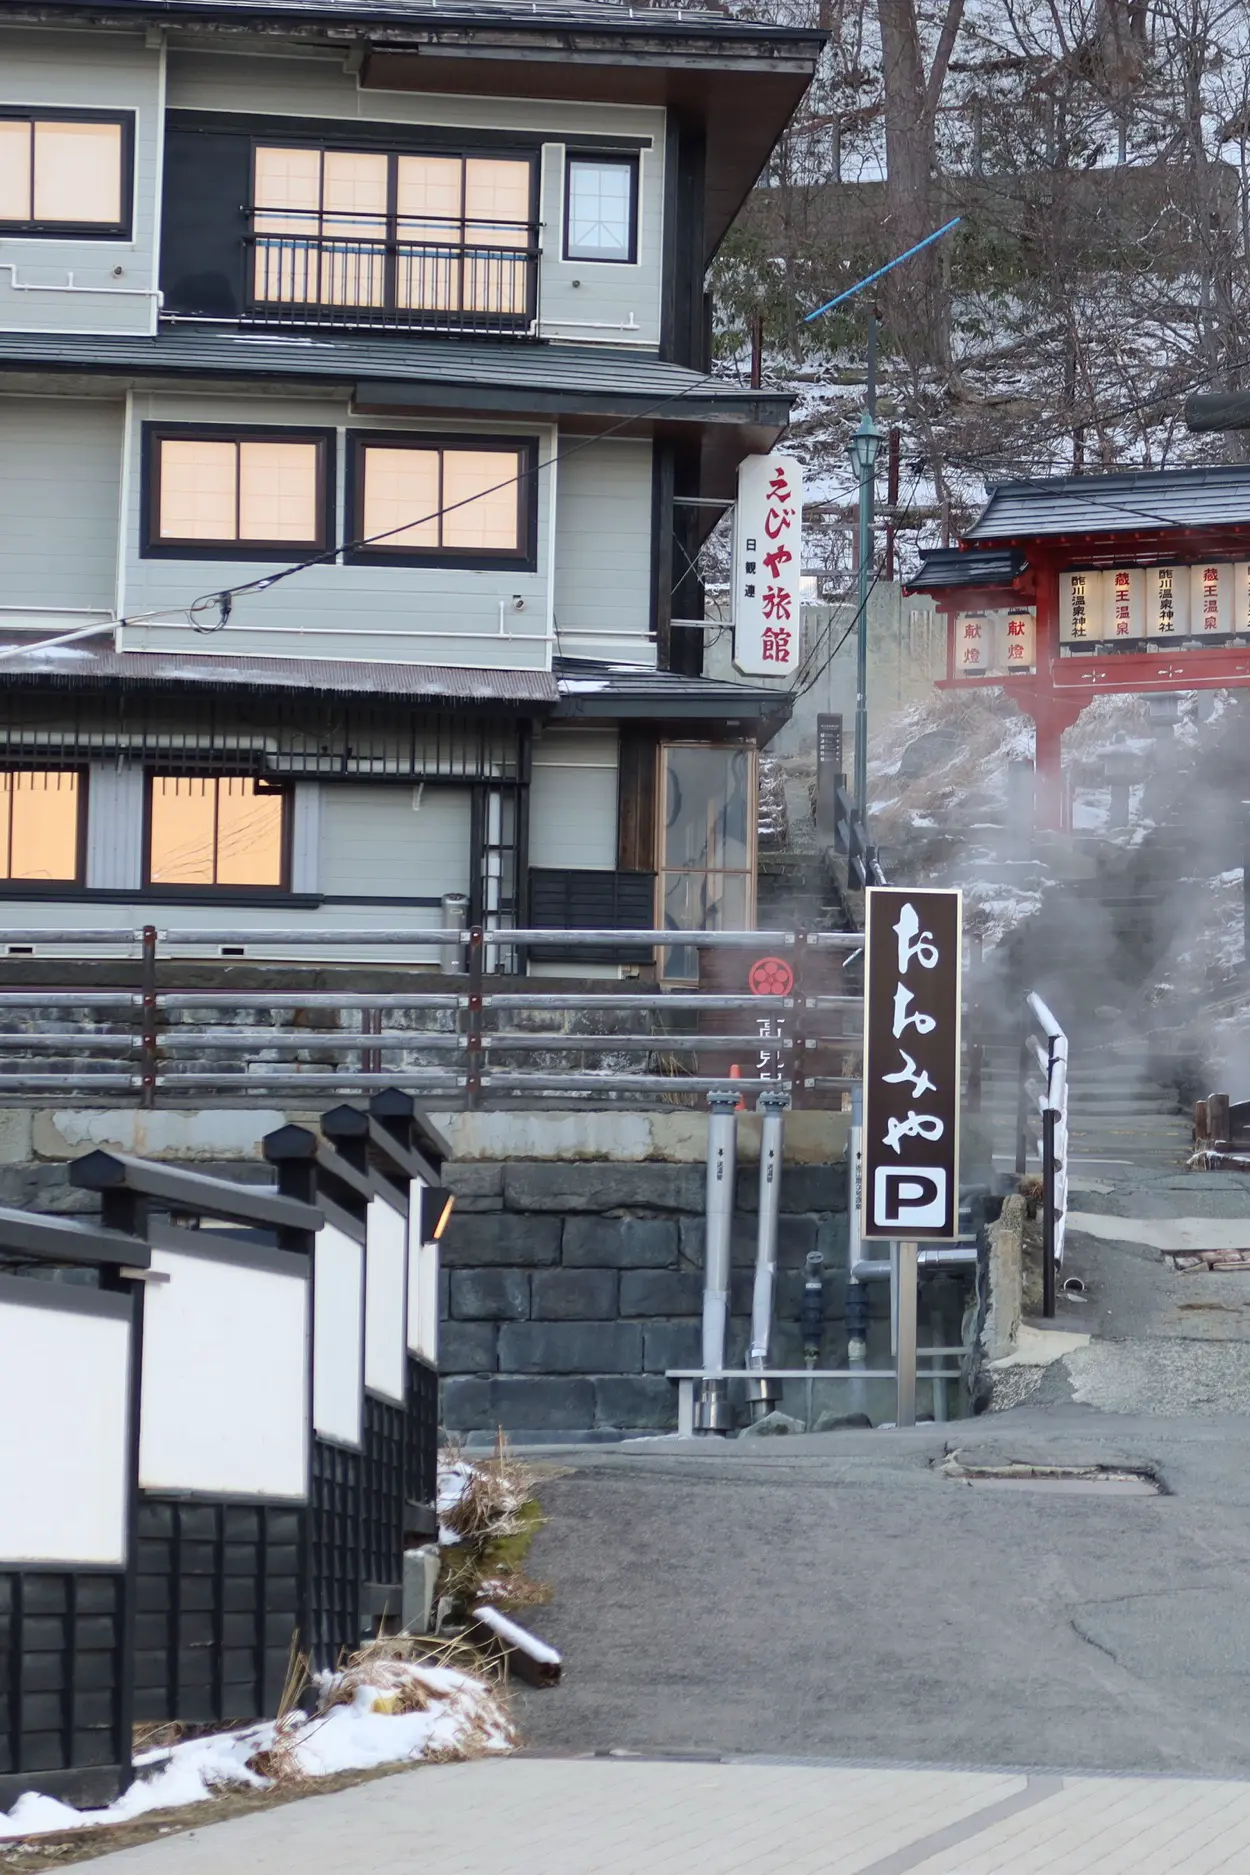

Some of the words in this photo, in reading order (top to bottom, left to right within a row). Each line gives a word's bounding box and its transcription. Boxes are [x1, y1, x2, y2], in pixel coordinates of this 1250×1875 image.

[744, 538, 757, 598] 日観連
[761, 467, 796, 663] えびや旅館
[1071, 576, 1087, 638] 酢川温泉神社
[1115, 572, 1130, 636] 蔵王温泉
[1159, 569, 1174, 632] 酢川温泉神社
[1203, 568, 1218, 630] 蔵王温泉
[881, 902, 945, 1155] おおみや
[885, 1174, 938, 1220] P
